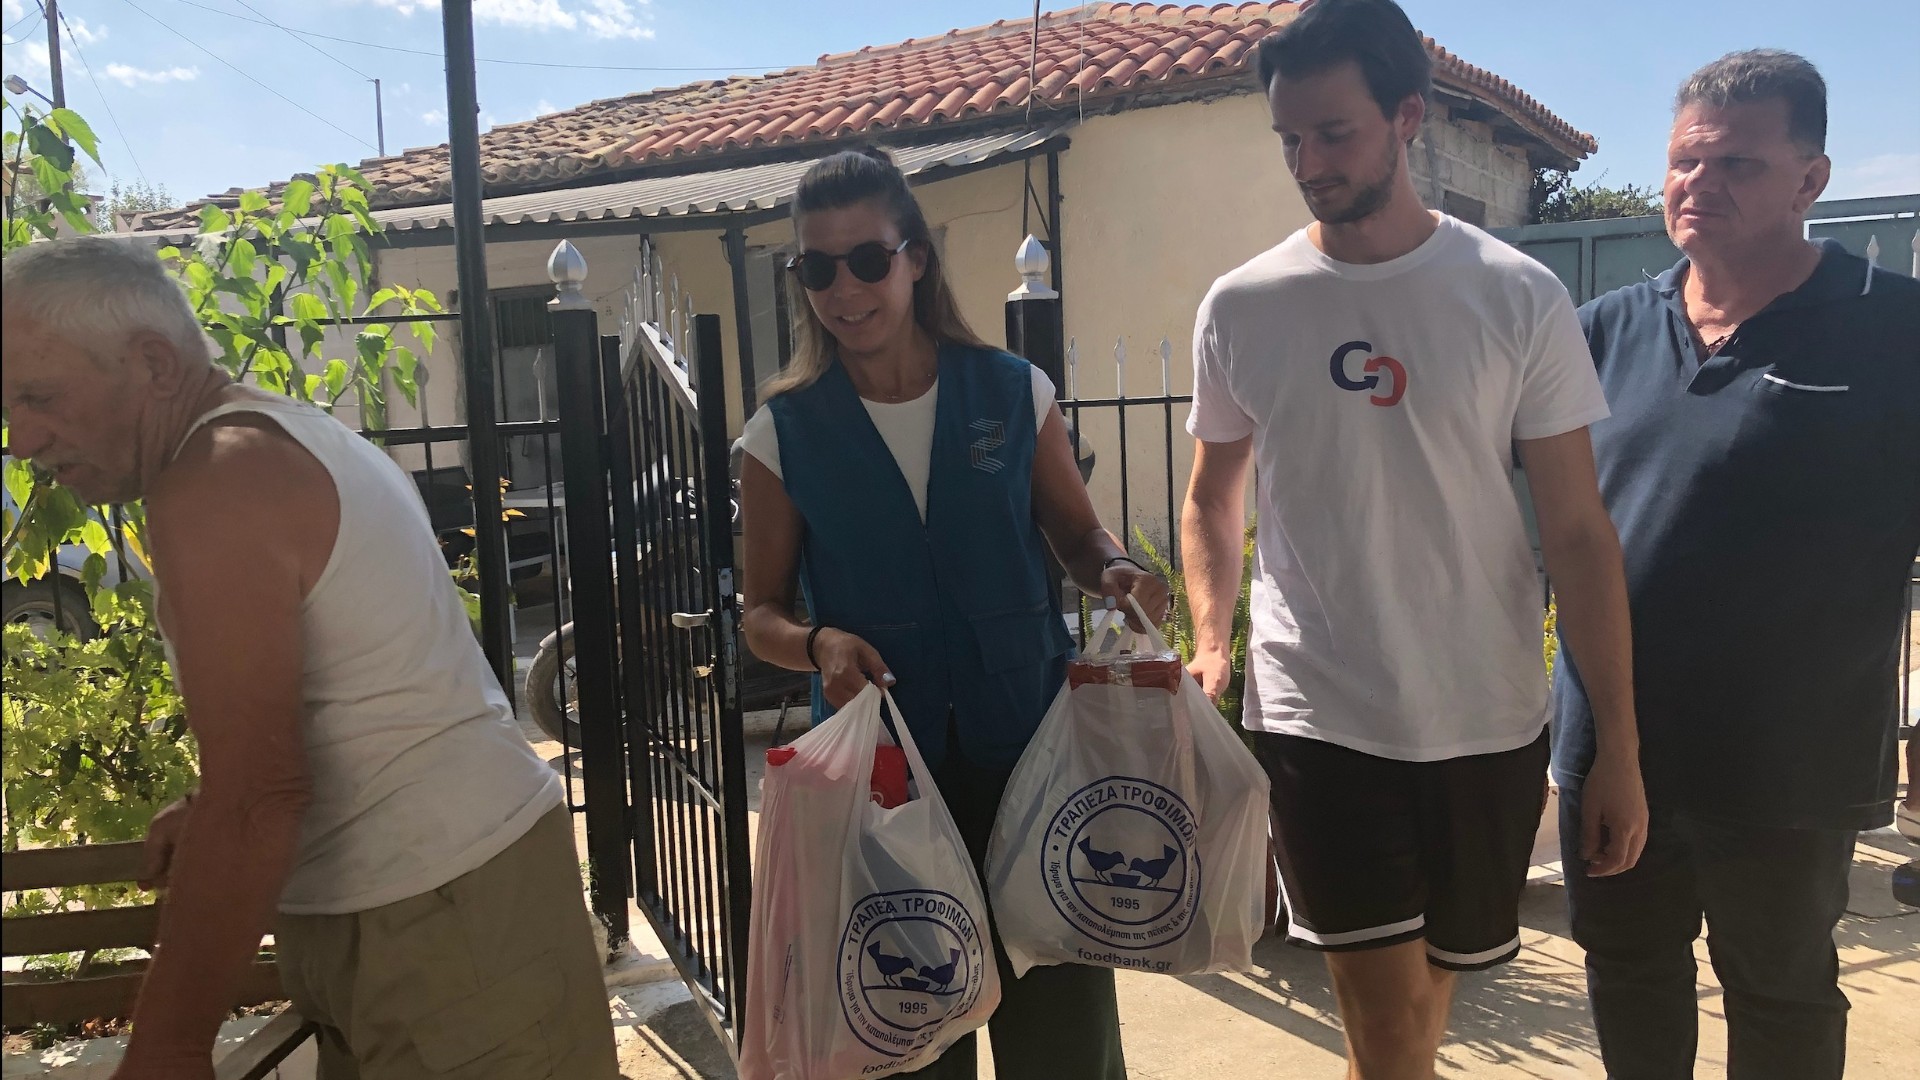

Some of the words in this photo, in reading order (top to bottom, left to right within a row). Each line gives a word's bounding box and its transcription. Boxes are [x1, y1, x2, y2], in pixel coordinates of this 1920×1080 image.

[1054, 785, 1118, 838] ΤΡΑΠΕΖΑ
[1121, 785, 1196, 847] ΤΡΟΦΙΜΩΝ
[1110, 896, 1141, 911] 1995
[848, 900, 898, 943] ΤΡΑΠΕΑ
[902, 898, 974, 943] ΤΡΟΦΙΜΩΝ
[1171, 917, 1180, 926] &
[1077, 947, 1173, 972] foodbank.gr
[898, 1001, 928, 1015] 1995
